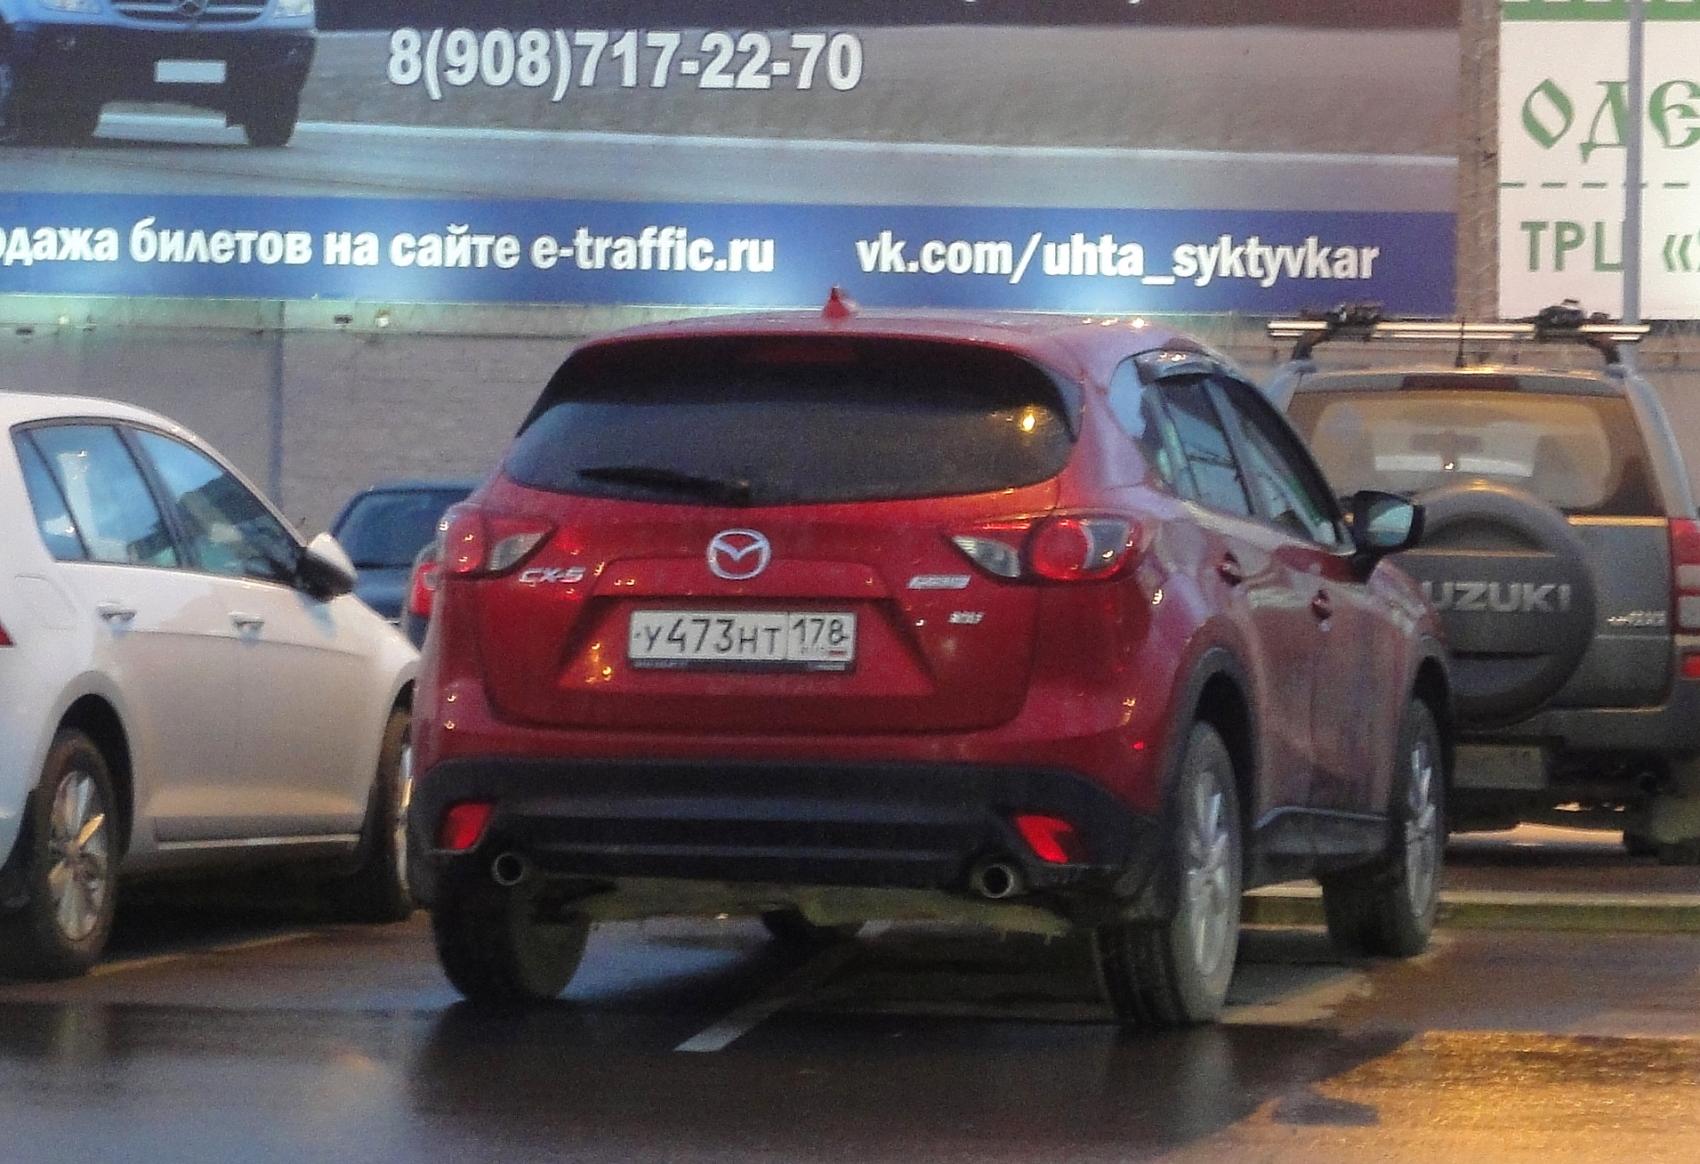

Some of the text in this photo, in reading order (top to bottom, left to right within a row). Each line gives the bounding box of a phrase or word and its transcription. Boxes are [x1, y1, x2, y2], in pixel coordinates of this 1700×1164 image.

[388, 27, 863, 101] 8(908)717-22-70
[129, 216, 312, 264] билетов
[322, 231, 379, 266] на
[389, 223, 521, 269] сайте
[529, 226, 775, 272] e-traffic.ru
[855, 230, 1379, 288] vk.com/uhta_syktyvkar
[518, 566, 586, 587] CX-5
